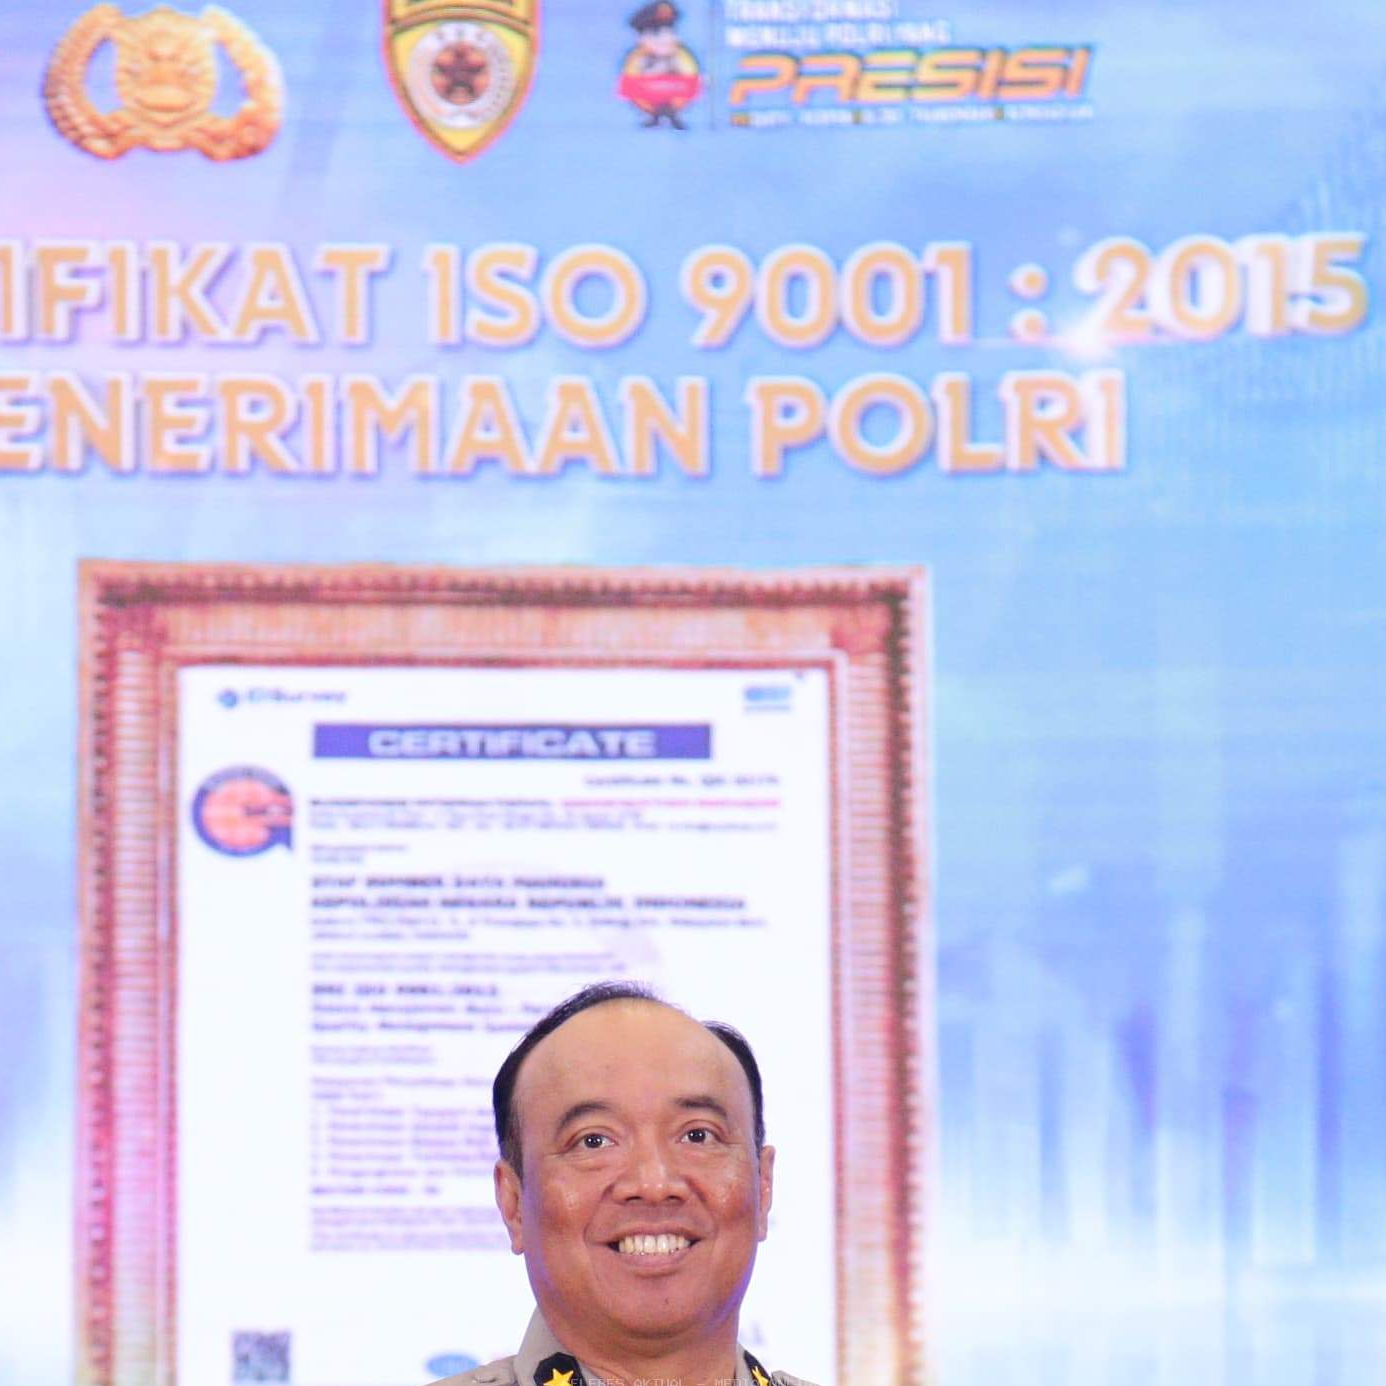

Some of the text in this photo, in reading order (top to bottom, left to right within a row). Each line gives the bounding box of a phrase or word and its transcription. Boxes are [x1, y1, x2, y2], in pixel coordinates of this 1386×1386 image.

[729, 47, 1090, 105] PRESISI
[422, 241, 645, 346] ISO
[682, 242, 972, 348] 9001
[1074, 232, 1367, 341] 2015
[749, 370, 1128, 476] POLRI
[368, 728, 658, 758] CERTIFICATE
